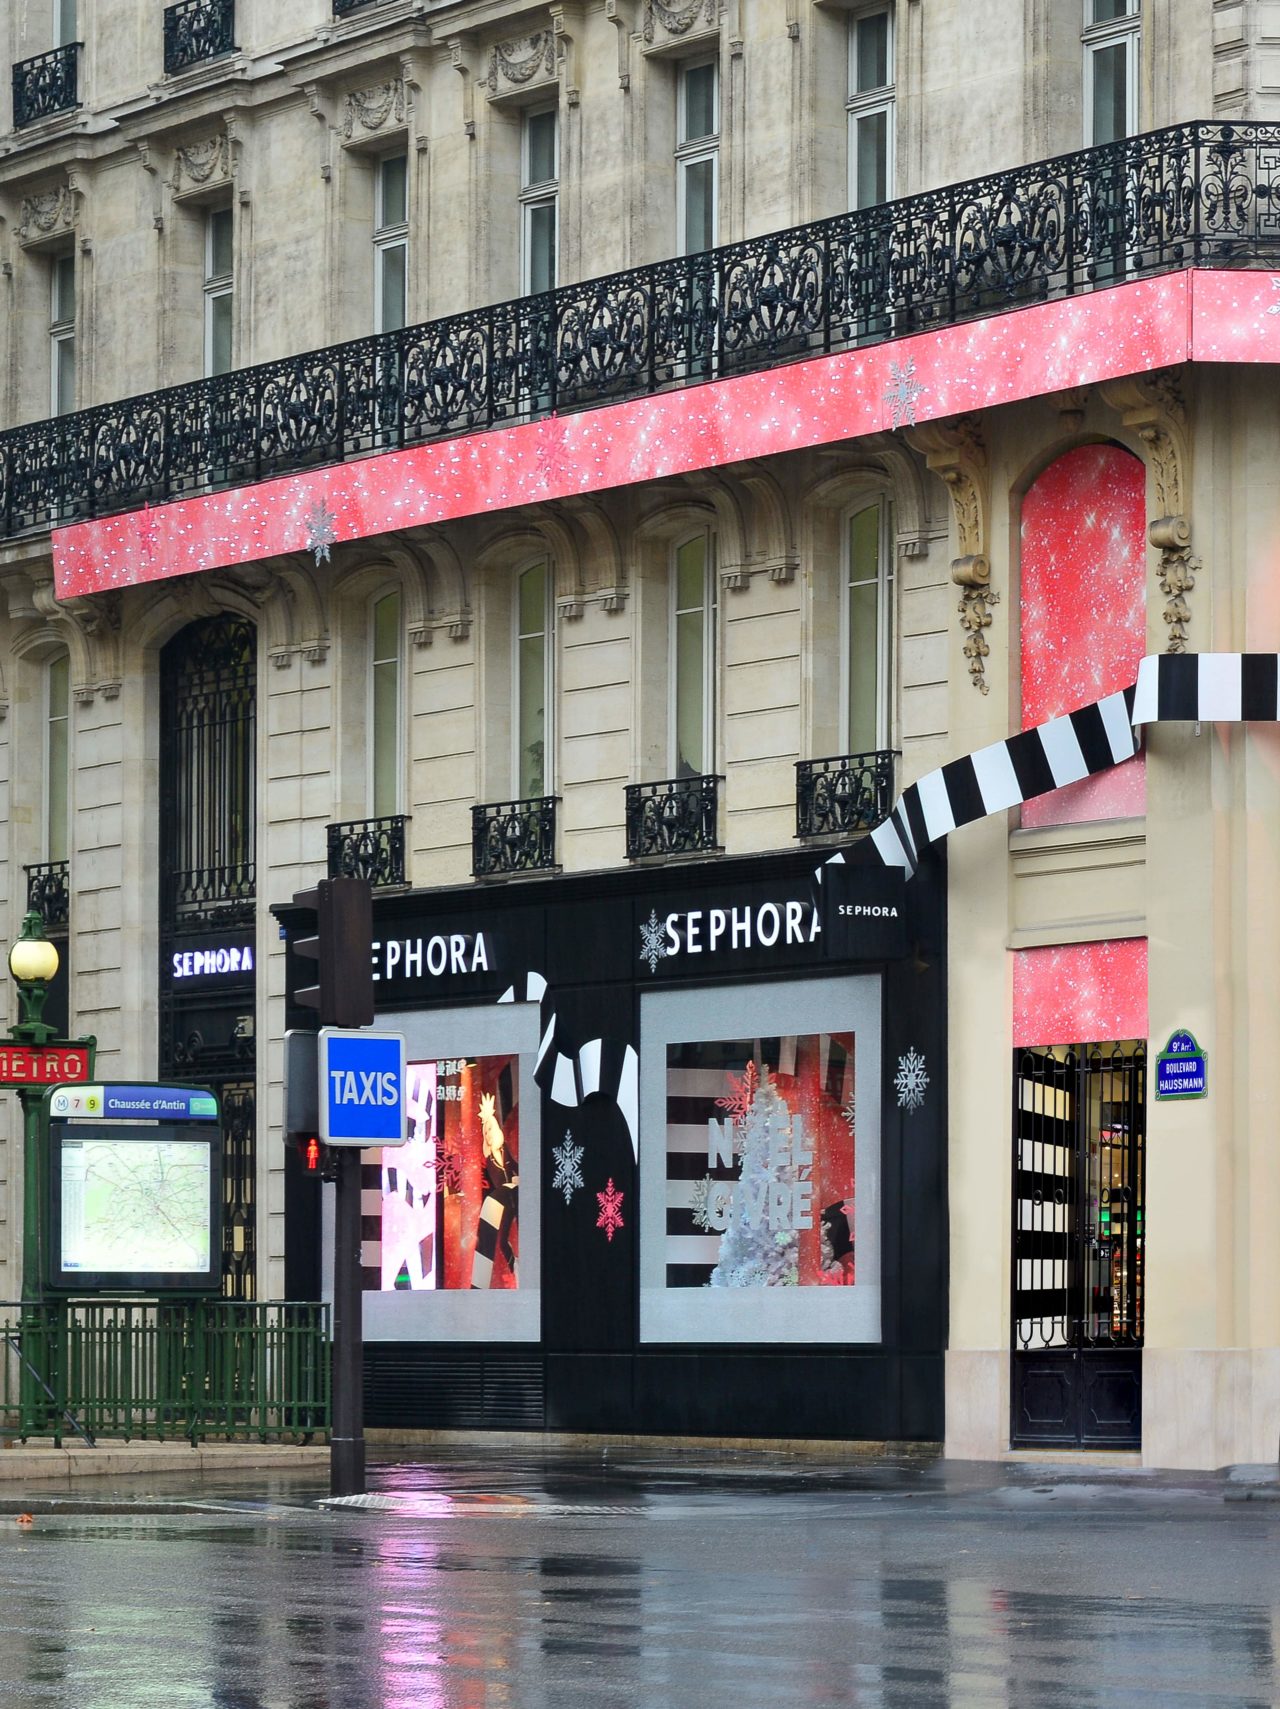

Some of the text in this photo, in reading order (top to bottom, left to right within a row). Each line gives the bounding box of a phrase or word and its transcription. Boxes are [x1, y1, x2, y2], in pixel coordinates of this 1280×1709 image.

[838, 904, 898, 917] SEPHORA
[173, 946, 252, 978] SEPHORA
[372, 932, 488, 981] EPHORA
[1165, 1061, 1197, 1074] BOULEVARD
[330, 1070, 398, 1106] TAXIS
[1159, 1077, 1203, 1091] HAUSSMANN
[74, 1098, 80, 1108] 7
[89, 1098, 96, 1109] 9
[108, 1098, 150, 1110] Chaussée
[152, 1098, 186, 1110] d'Antin
